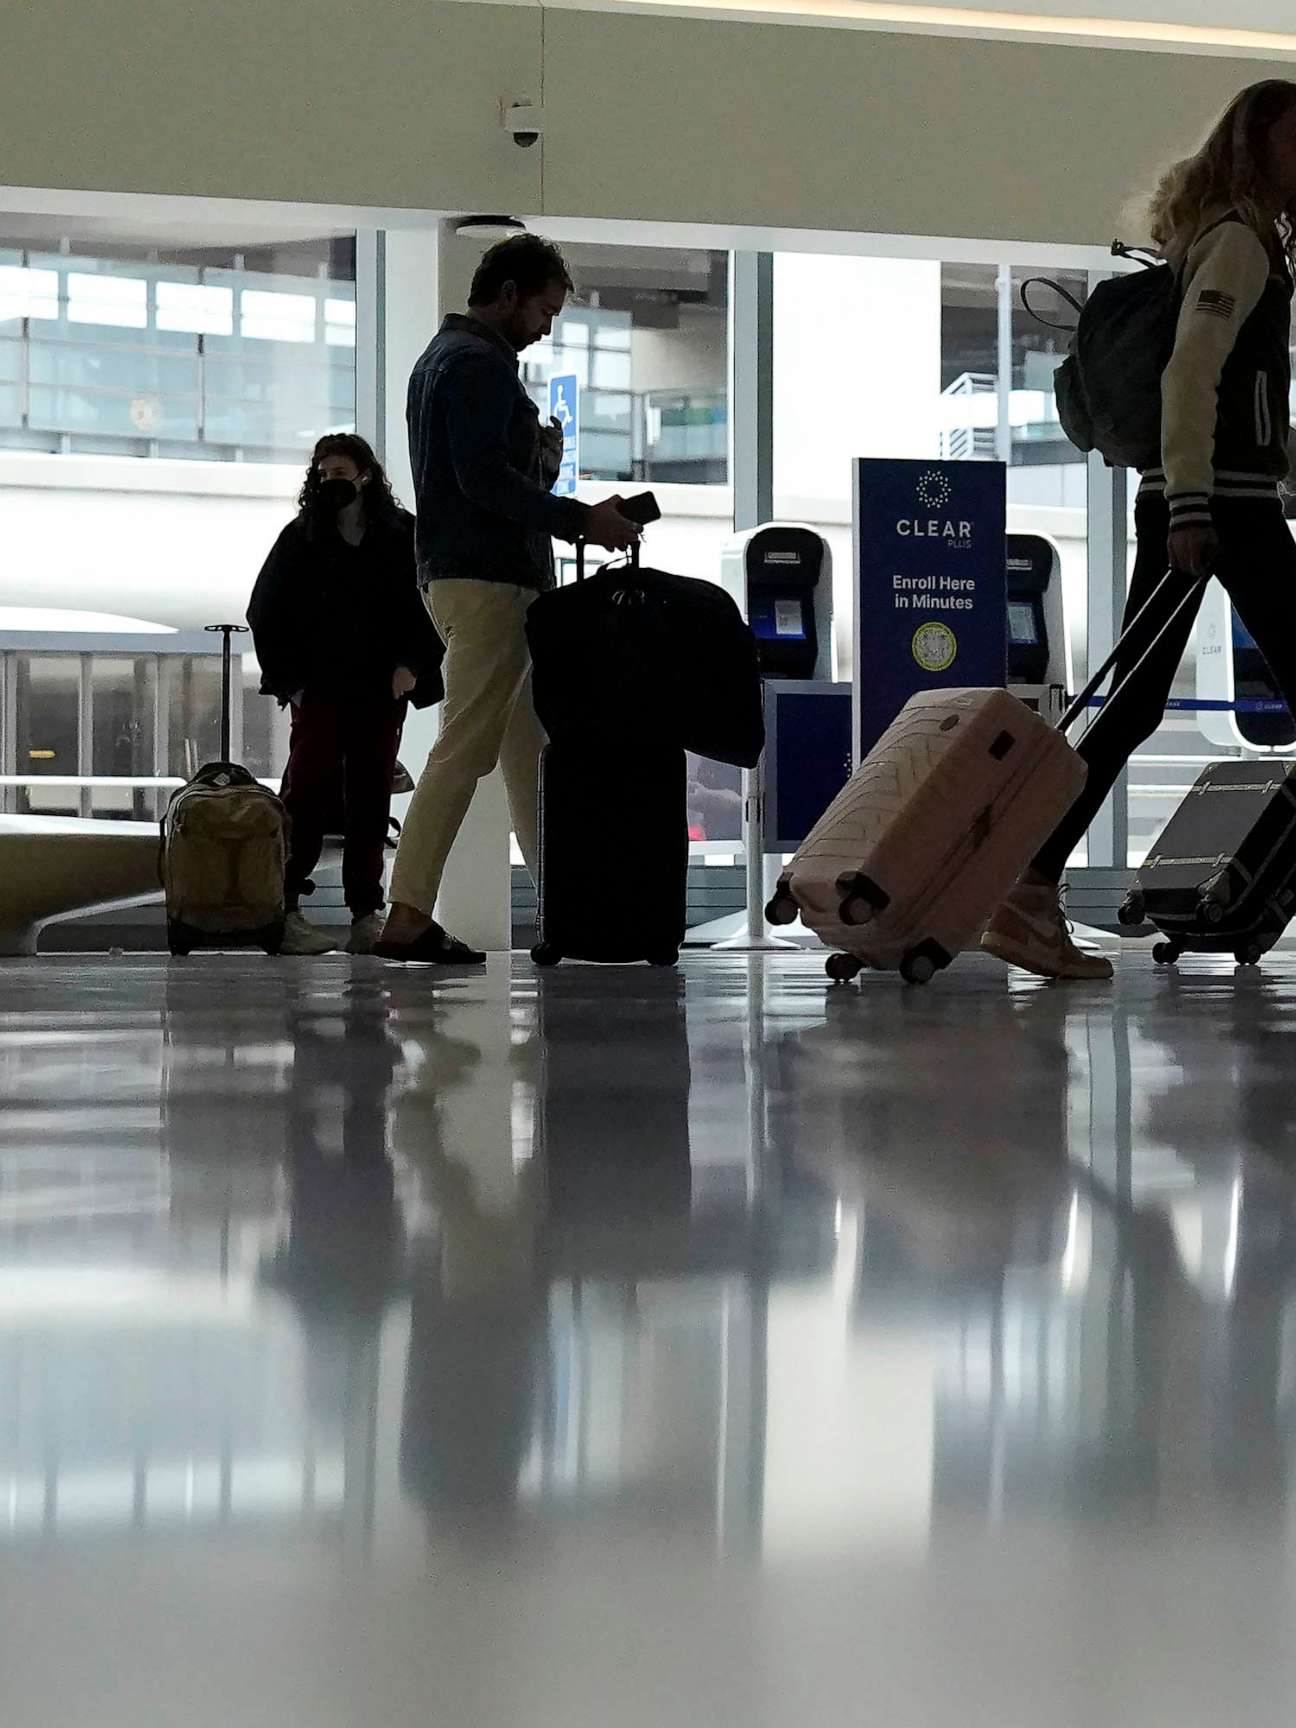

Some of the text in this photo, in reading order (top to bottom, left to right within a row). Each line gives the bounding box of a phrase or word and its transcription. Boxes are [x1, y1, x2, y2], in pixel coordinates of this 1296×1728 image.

[896, 519, 972, 538] CLEAR
[893, 575, 976, 590] Enroll Here
[895, 593, 973, 609] in Minutes
